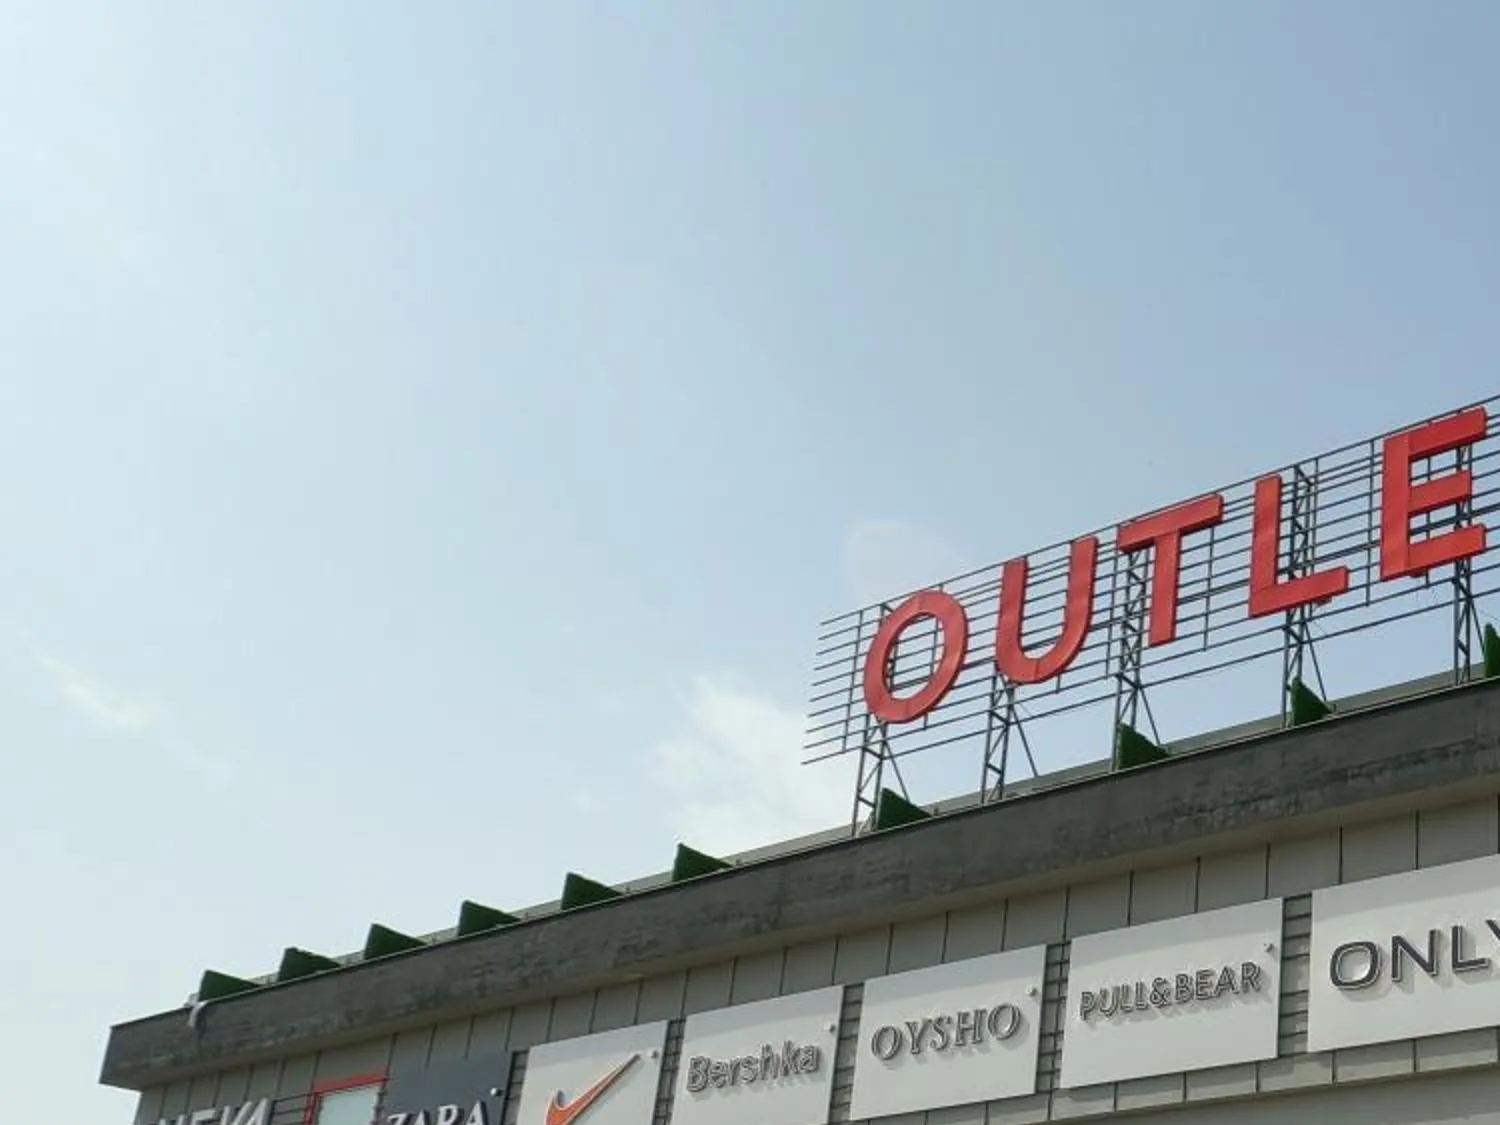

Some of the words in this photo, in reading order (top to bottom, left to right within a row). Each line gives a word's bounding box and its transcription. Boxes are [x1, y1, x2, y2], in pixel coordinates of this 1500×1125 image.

[1079, 961, 1262, 1022] PULL&BEAR
[871, 1003, 1022, 1060] OYSHO
[687, 1040, 819, 1092] Bershka
